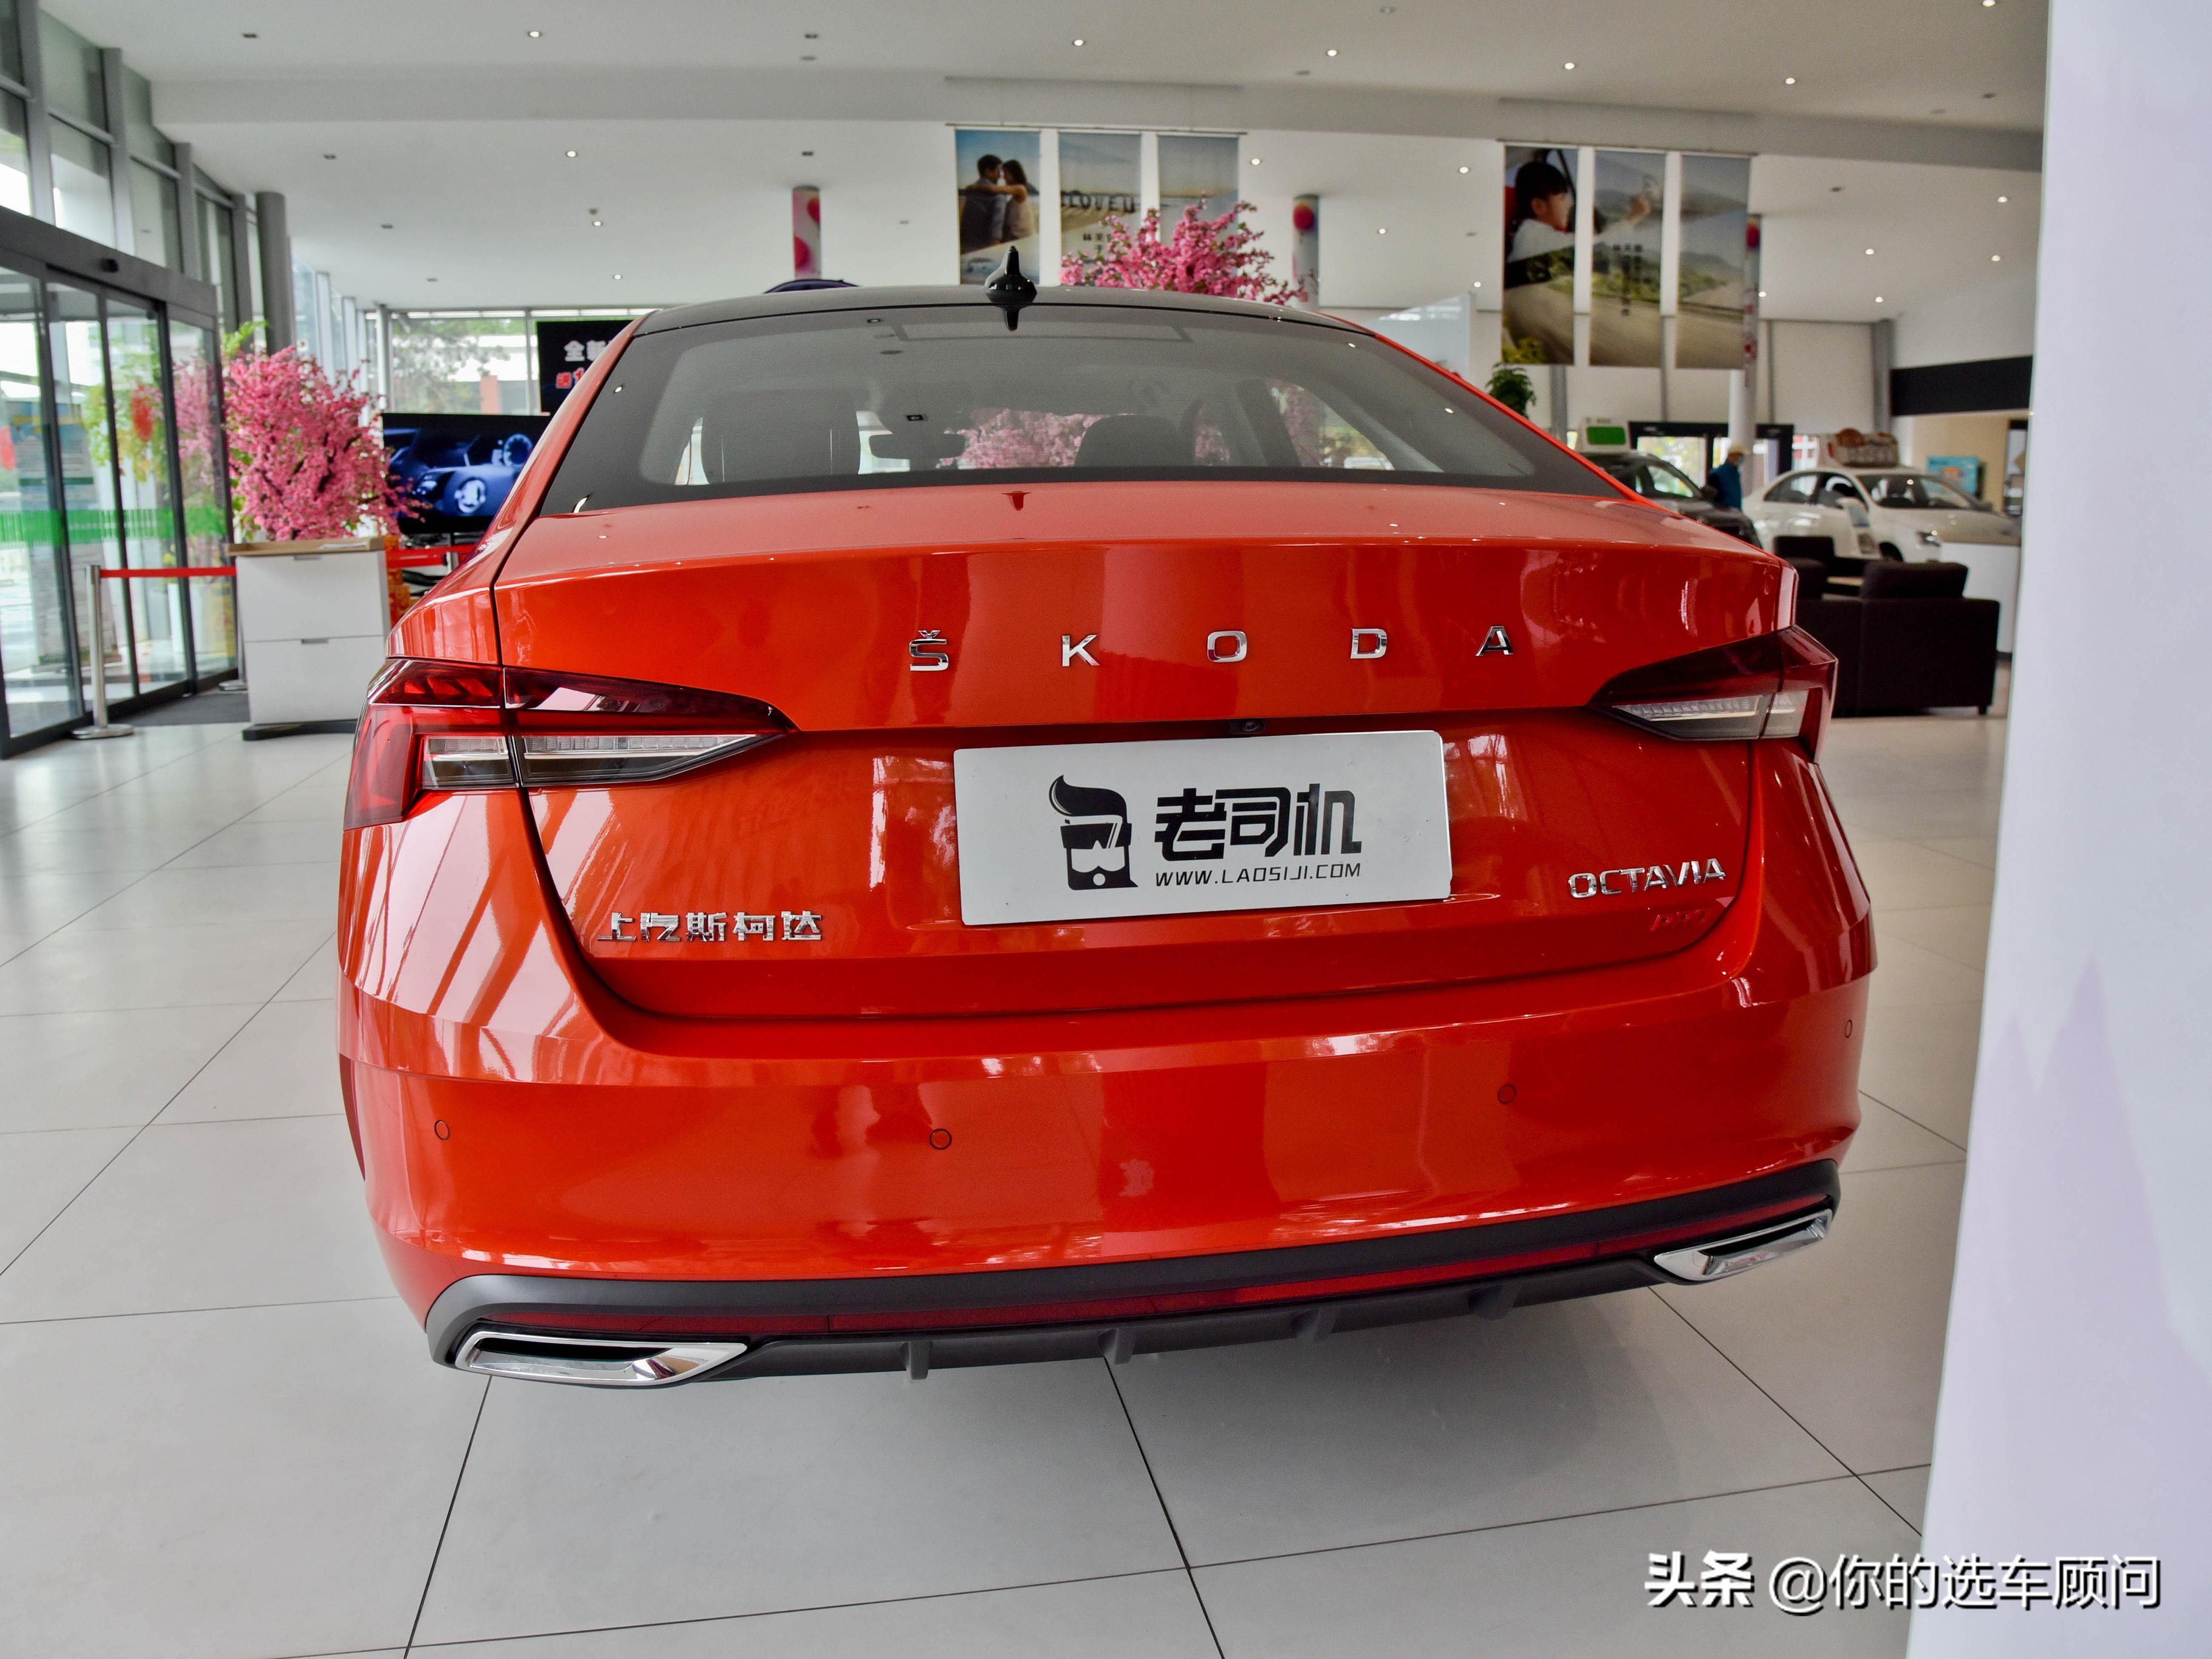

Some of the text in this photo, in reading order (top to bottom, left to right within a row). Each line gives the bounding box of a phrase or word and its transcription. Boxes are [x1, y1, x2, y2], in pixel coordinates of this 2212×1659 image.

[909, 625, 1513, 672] ŠKODA
[1155, 783, 1362, 861] 老司机
[1156, 863, 1360, 886] WWW.LAOSIJI.COM
[1568, 858, 1725, 898] OCTAVIA
[597, 910, 822, 941] 上汽斯柯达
